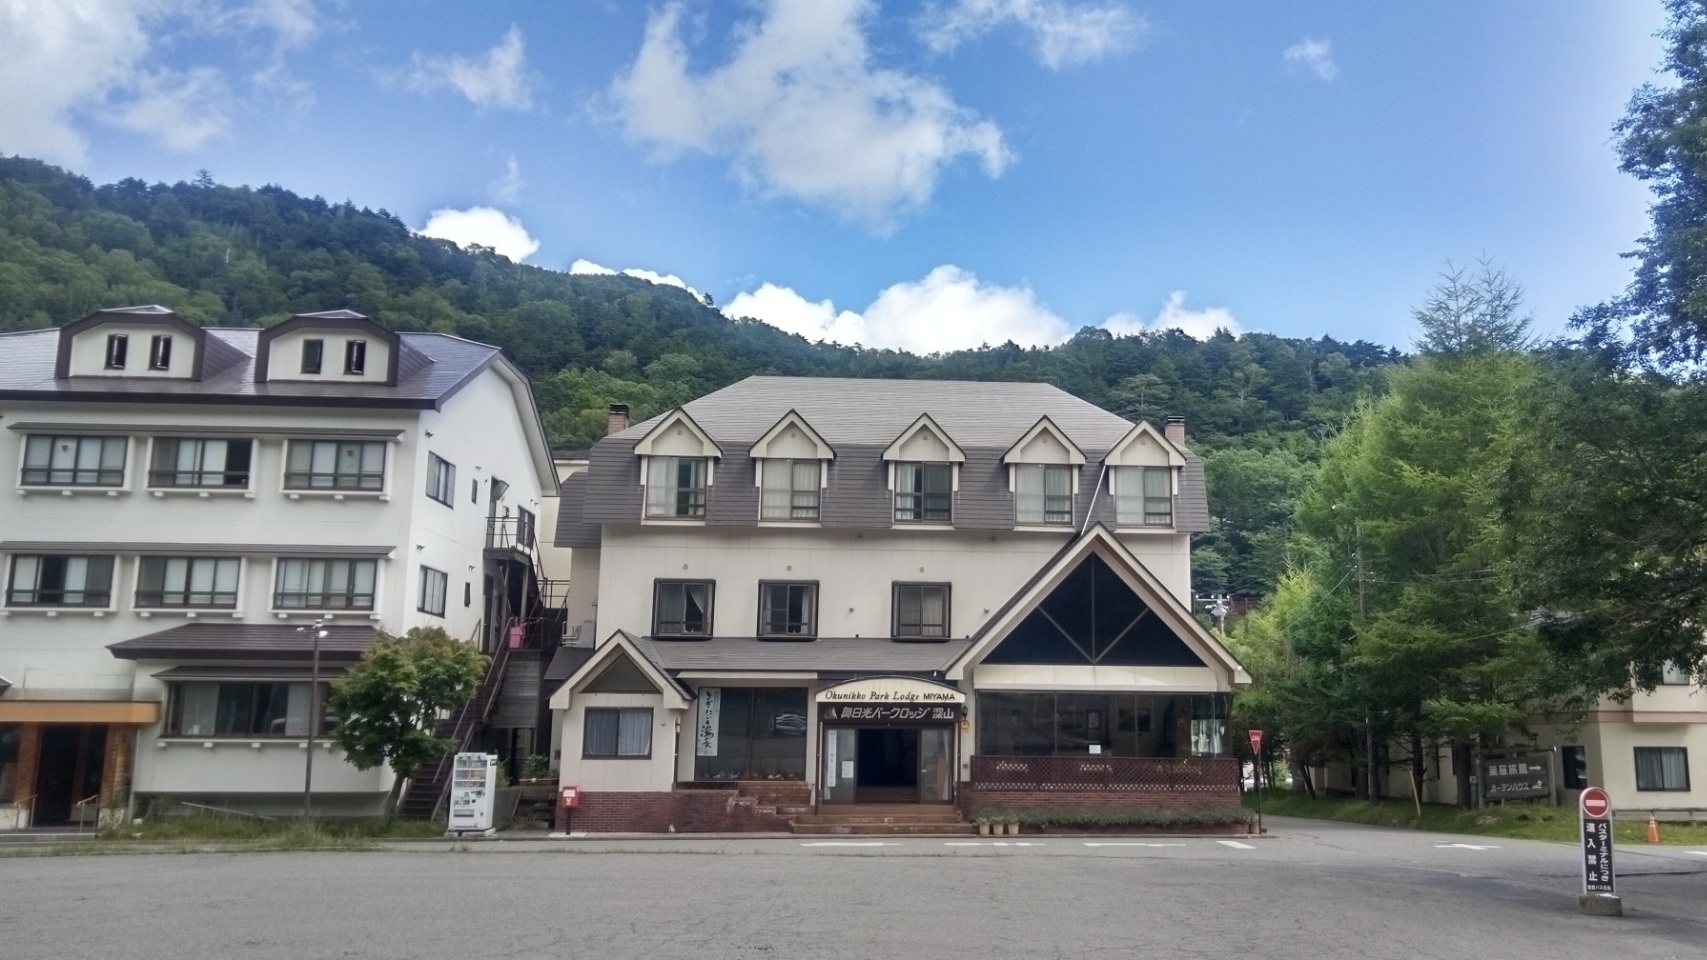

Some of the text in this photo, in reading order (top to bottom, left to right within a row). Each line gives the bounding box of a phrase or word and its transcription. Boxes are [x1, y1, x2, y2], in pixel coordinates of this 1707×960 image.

[825, 690, 866, 700] Okunikko
[869, 691, 889, 700] Park
[893, 691, 919, 702] Lodge
[1586, 823, 1598, 881] 進入禁止
